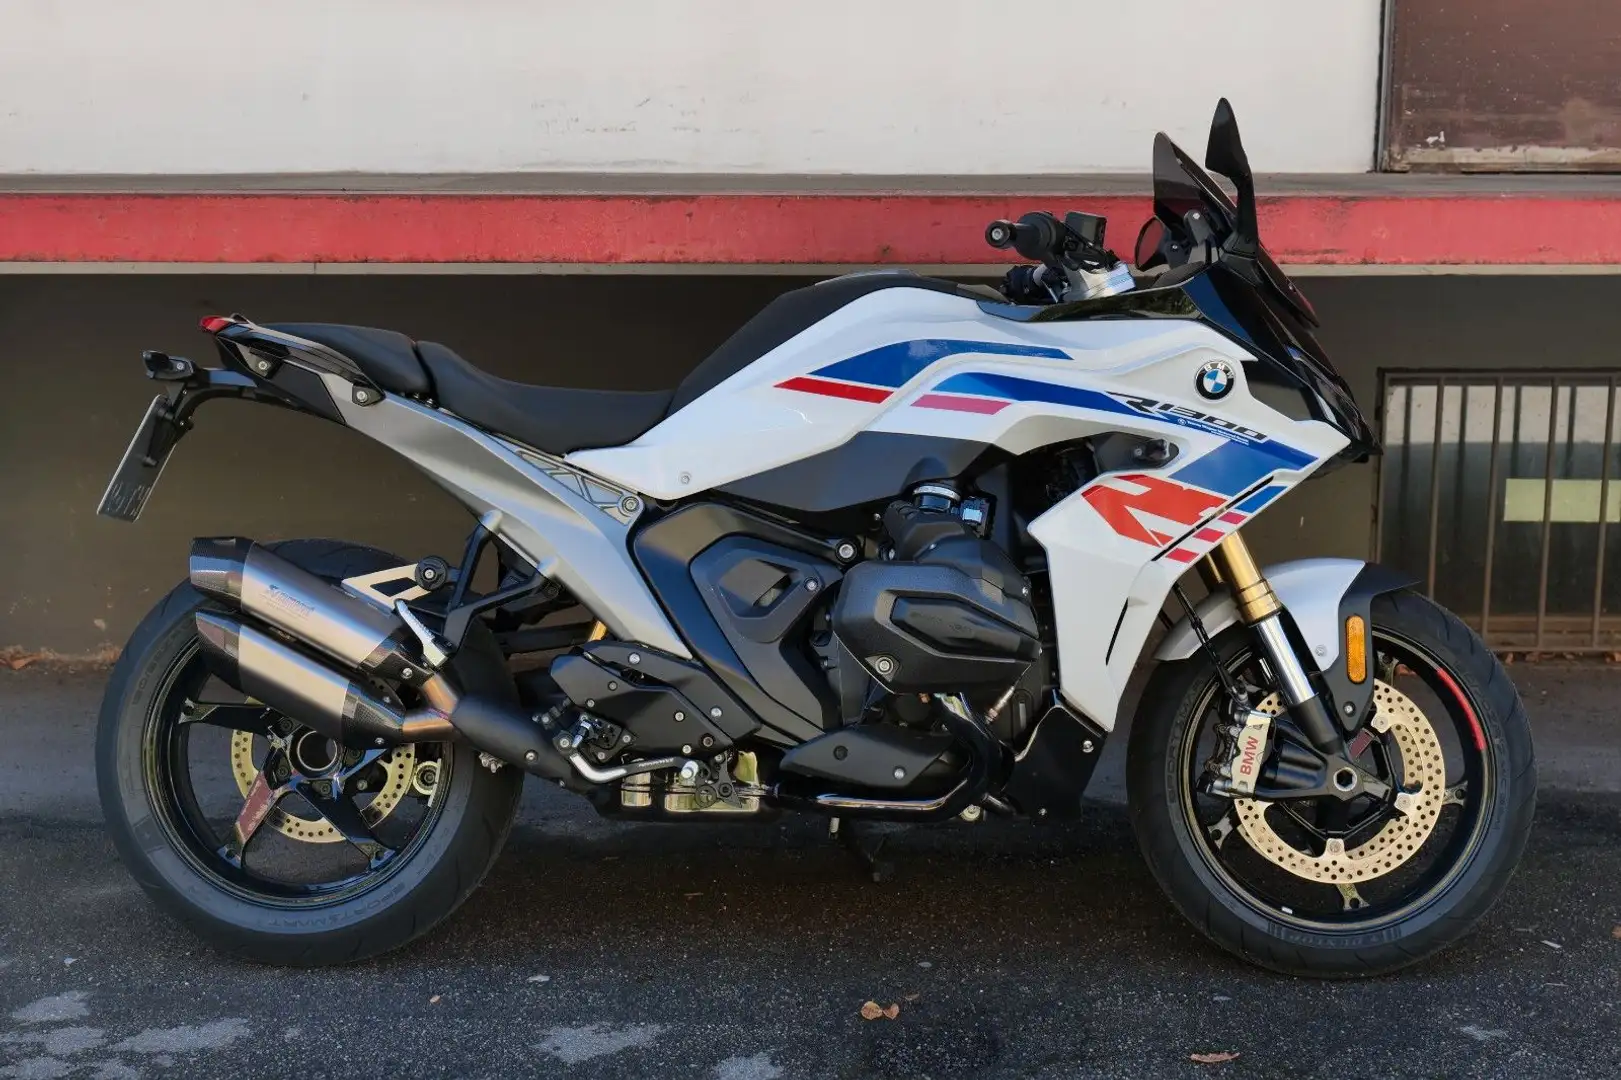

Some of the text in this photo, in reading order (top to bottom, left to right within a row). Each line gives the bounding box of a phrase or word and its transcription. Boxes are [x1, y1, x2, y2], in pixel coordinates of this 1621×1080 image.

[1204, 362, 1234, 379] BMW
[1105, 391, 1268, 441] R1300
[1240, 736, 1259, 775] BMW
